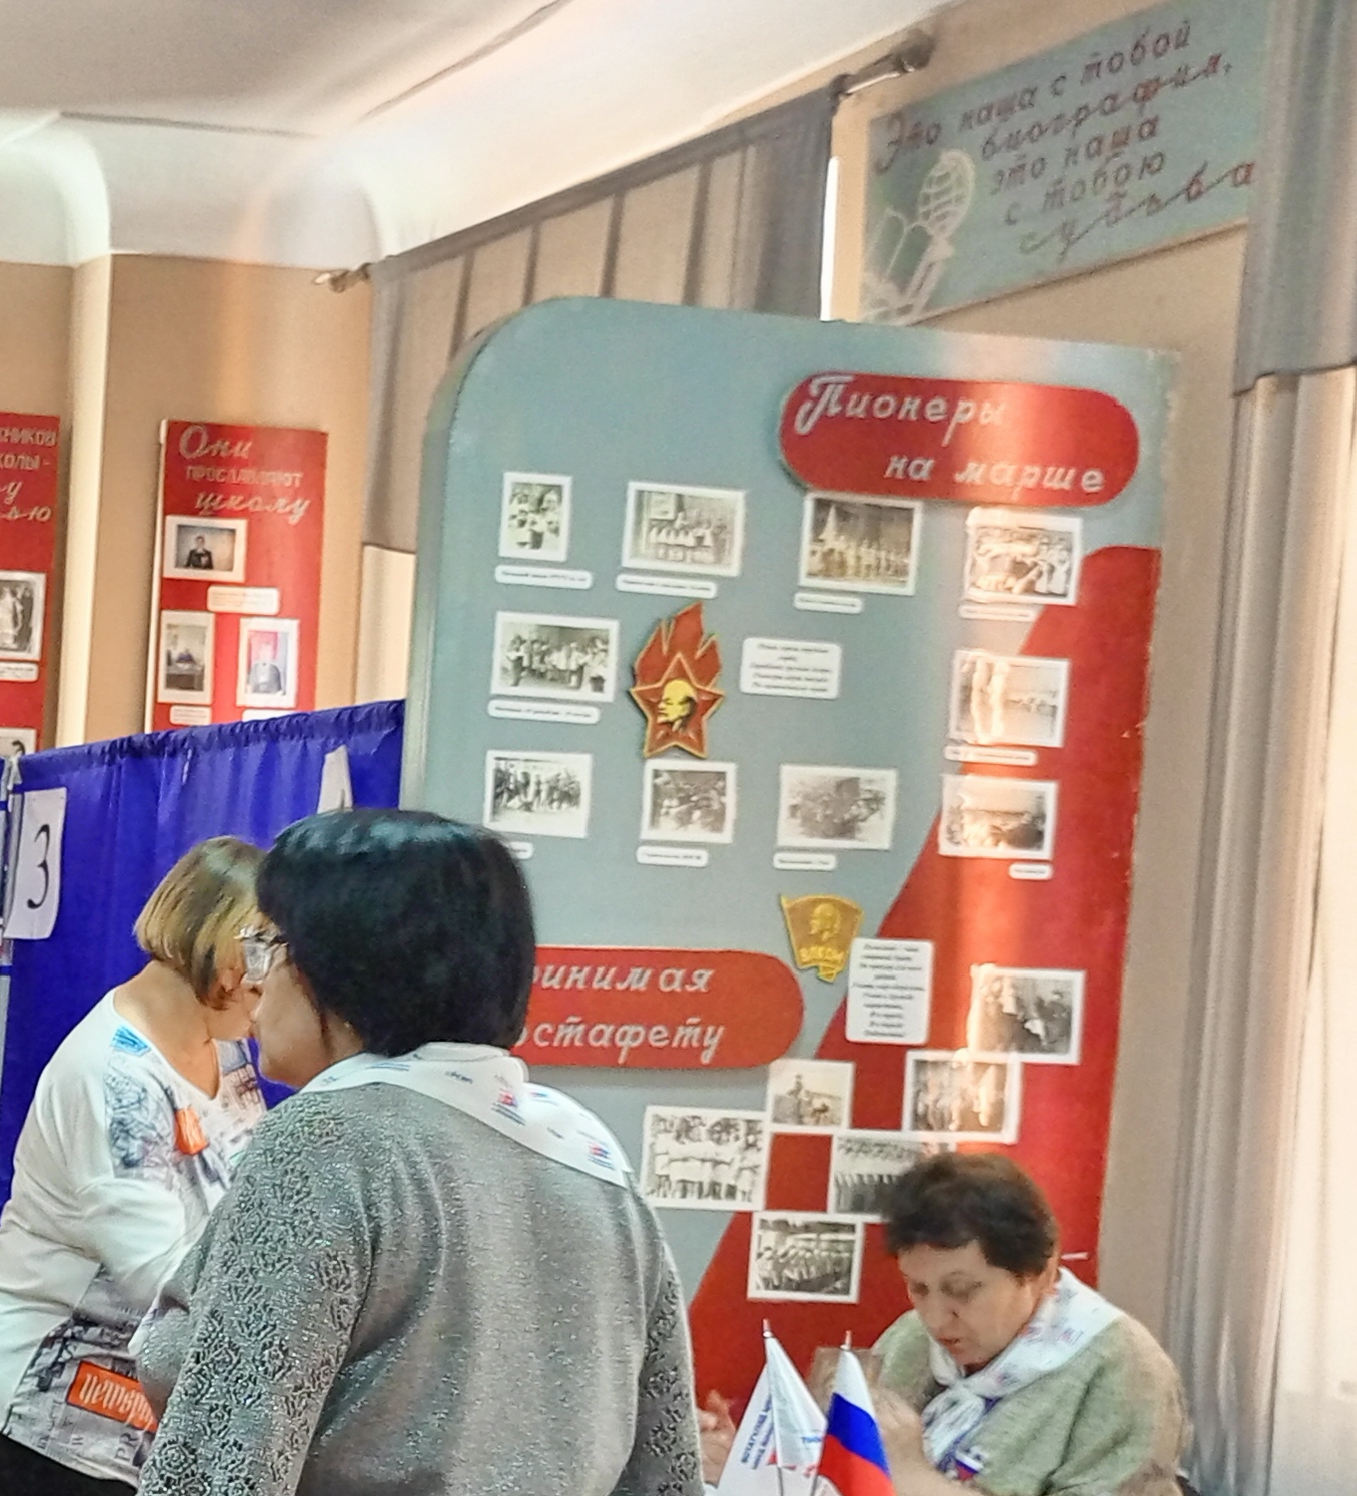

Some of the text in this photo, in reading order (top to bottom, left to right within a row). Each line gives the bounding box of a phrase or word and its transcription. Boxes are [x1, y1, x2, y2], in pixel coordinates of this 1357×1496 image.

[958, 86, 1038, 133] наша
[1079, 20, 1190, 86] тобой
[991, 115, 1159, 195] это наша
[1042, 150, 1165, 213] тобою
[793, 375, 1009, 448] Пионеры
[884, 454, 1105, 501] на марше
[27, 824, 51, 910] 3
[531, 963, 715, 993] инимая
